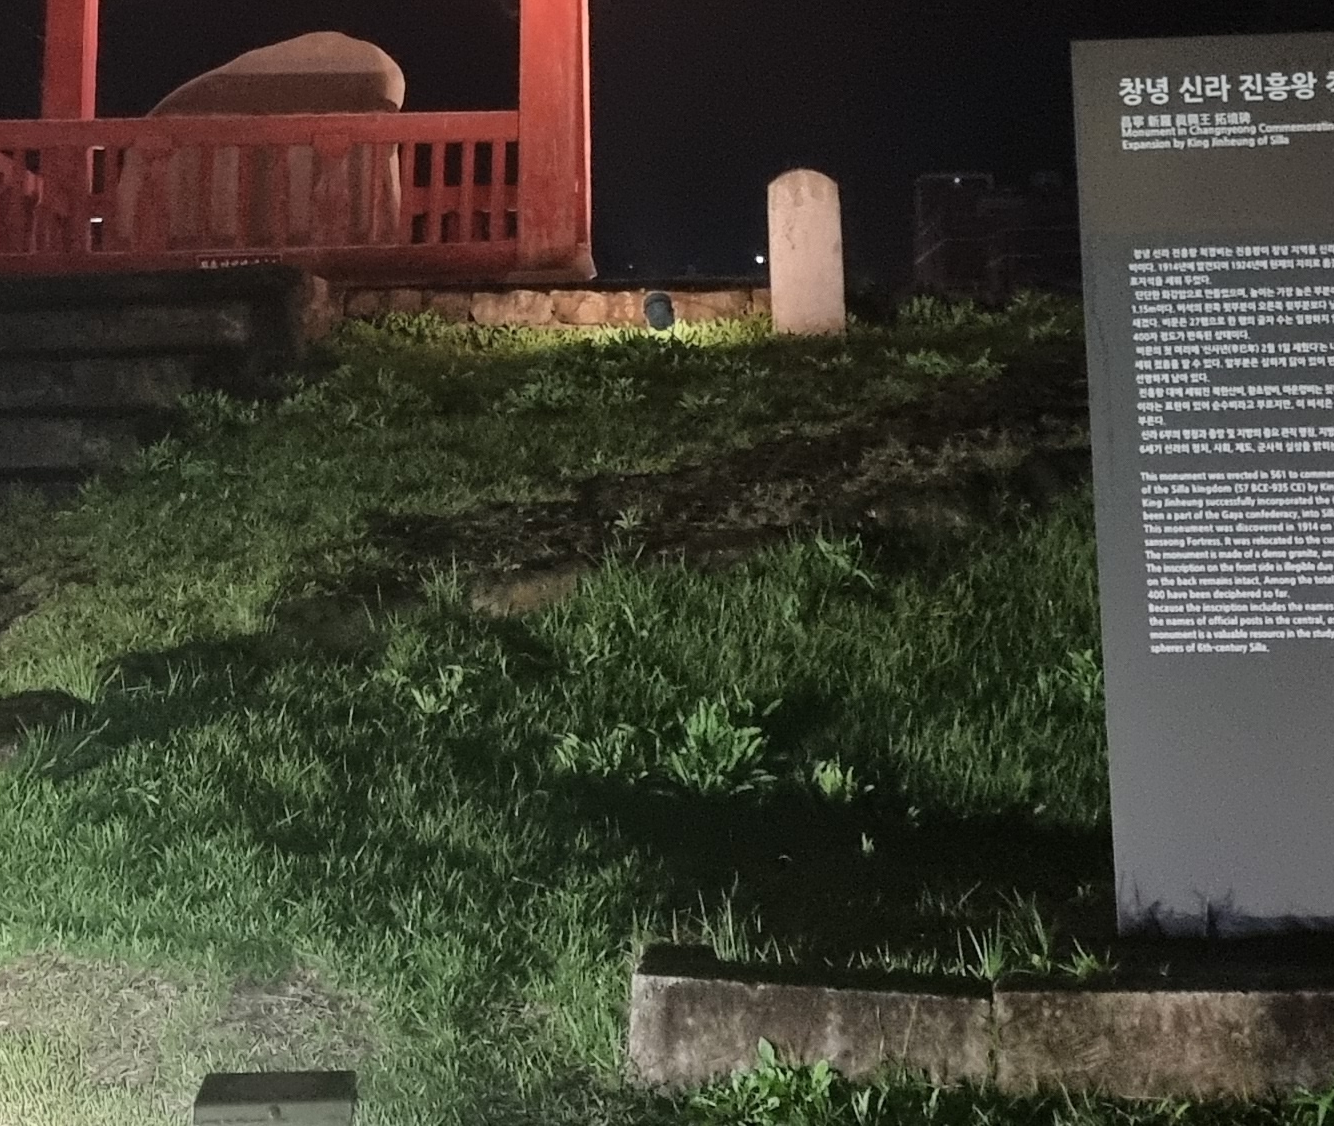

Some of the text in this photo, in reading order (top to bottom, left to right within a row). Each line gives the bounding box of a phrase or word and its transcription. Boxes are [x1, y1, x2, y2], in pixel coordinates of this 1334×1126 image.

[1118, 76, 1170, 106] 창녕
[1178, 74, 1230, 104] 신라
[1238, 71, 1317, 102] 진흥왕
[1121, 125, 1176, 138] Monument
[1177, 125, 1188, 136] in
[1189, 123, 1256, 137] Changnyeong
[1122, 134, 1290, 151] Expansion by King Jinheung of Silla
[1140, 471, 1157, 481] This
[1159, 472, 1206, 480] monument
[1226, 470, 1258, 479] erected
[1270, 469, 1286, 478] 561
[1153, 484, 1169, 493] the
[1171, 484, 1189, 493] Silla
[1191, 483, 1232, 494] kingdom
[1141, 498, 1162, 508] King
[1164, 497, 1203, 508] Jinheung
[1205, 496, 1255, 506] successfully
[1257, 495, 1313, 506] incorporated
[1315, 495, 1329, 504] the
[1142, 510, 1164, 520] been
[1174, 511, 1191, 520] part
[1205, 510, 1219, 519] the
[1221, 510, 1243, 520] Gaya
[1302, 509, 1319, 517] into
[1143, 523, 1162, 533] This
[1163, 524, 1213, 532] monument
[1235, 522, 1283, 531] discovered
[1297, 522, 1318, 531] 1914
[1186, 536, 1222, 546] Fortress.
[1252, 535, 1292, 544] relocated
[1305, 535, 1320, 544] the
[1160, 576, 1174, 585] the
[1176, 576, 1196, 585] back
[1199, 577, 1232, 585] remains
[1263, 575, 1296, 586] Among
[1297, 574, 1312, 584] the
[1313, 575, 1334, 583] total
[1147, 590, 1165, 599] 400
[1166, 589, 1187, 598] have
[1189, 589, 1210, 598] been
[1213, 588, 1261, 599] deciphered
[1148, 602, 1183, 612] Because
[1186, 603, 1200, 612] the
[1202, 603, 1247, 612] inscription
[1250, 601, 1286, 611] includes
[1287, 602, 1303, 611] the
[1148, 616, 1163, 625] the
[1208, 615, 1237, 625] official
[1239, 616, 1263, 625] posts
[1275, 615, 1290, 624] the
[1292, 615, 1325, 625] central,
[1150, 643, 1184, 653] spheres
